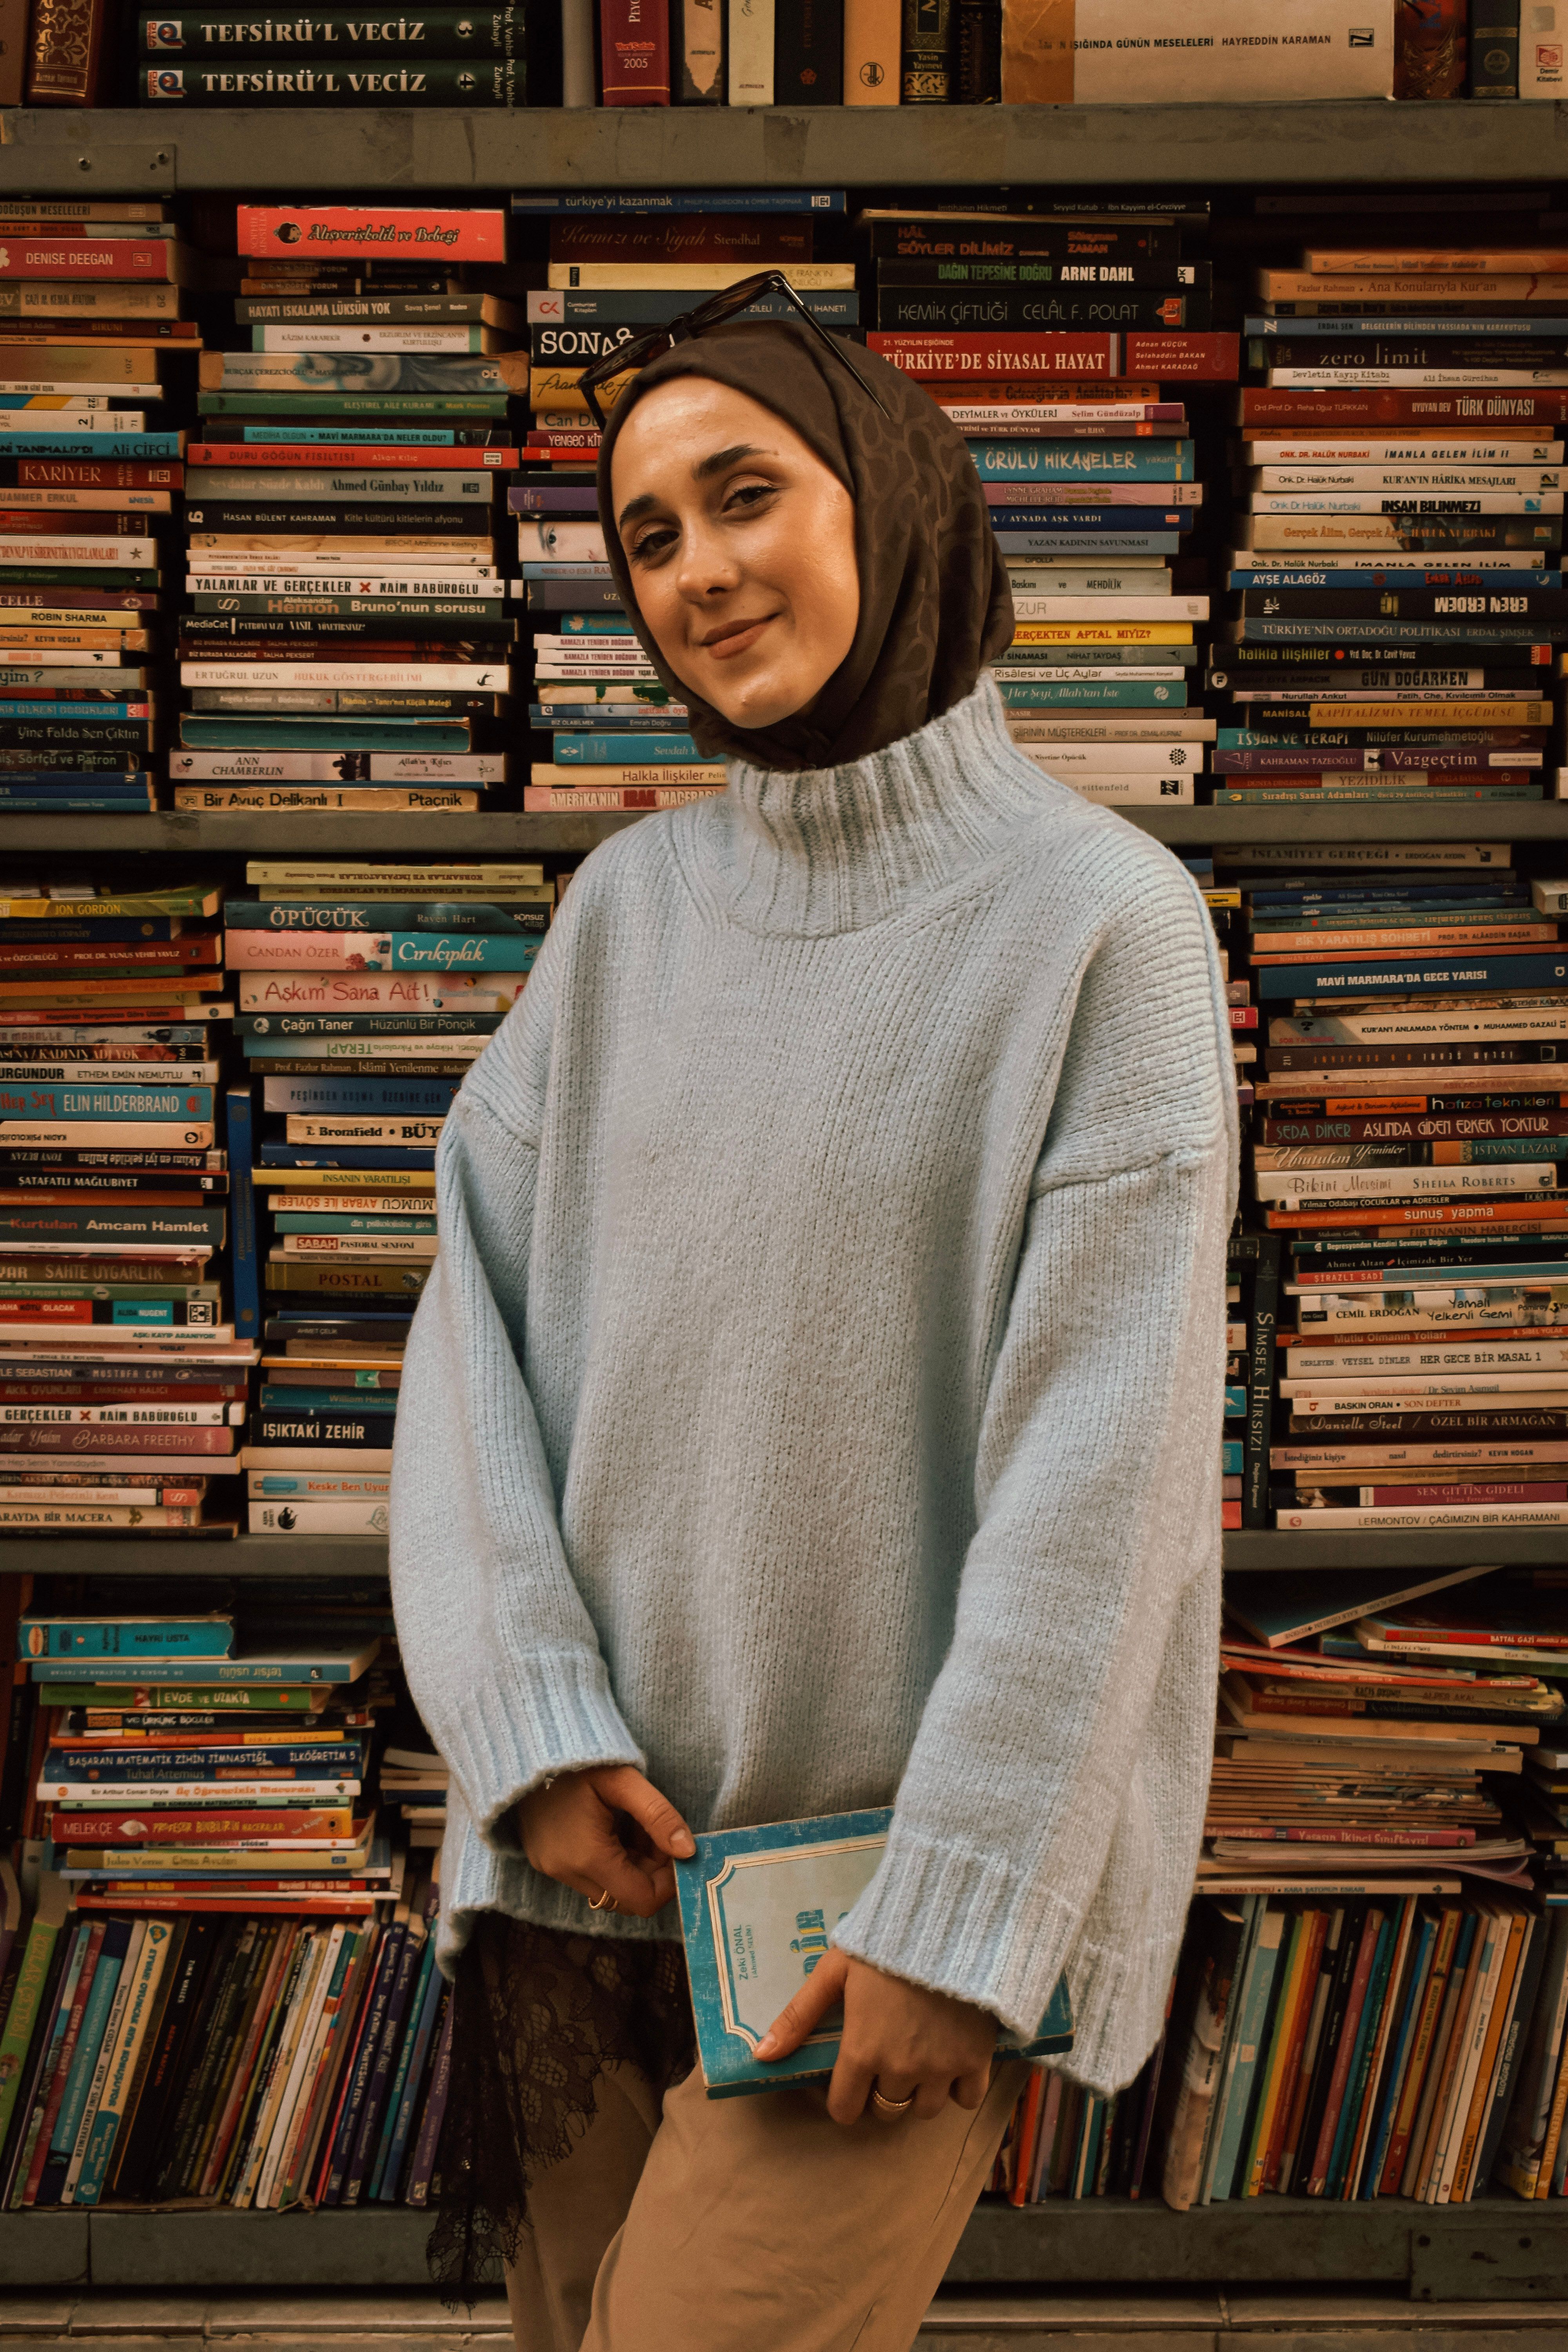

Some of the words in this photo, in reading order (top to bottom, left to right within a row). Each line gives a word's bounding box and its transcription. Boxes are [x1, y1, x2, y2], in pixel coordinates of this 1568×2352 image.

[200, 19, 338, 42] TEFSİRÜ'L
[346, 18, 425, 41] VECİZ
[458, 21, 473, 36] 3
[1116, 38, 1151, 49] GÜNÜN
[1154, 36, 1214, 48] MESELELERİ
[1222, 35, 1279, 46] HAYREDDİN
[1282, 34, 1331, 45] KARAMAN
[623, 58, 648, 69] 2005
[201, 69, 340, 92] TEFSİRÜ'L
[348, 69, 426, 91] VECİZ
[459, 74, 474, 87] 4
[565, 196, 616, 208] türkiye'yi
[620, 196, 672, 206] kazanmak
[398, 230, 411, 241] ve
[416, 229, 458, 245] Bebeği
[714, 234, 760, 245] Stendhal
[26, 253, 65, 265] DENISE
[69, 253, 113, 265] DEEGAN
[1060, 267, 1096, 281] ARNE
[1100, 267, 1134, 281] DAHL
[249, 306, 280, 317] HAYATI
[333, 301, 368, 315] LÜKSÜN
[372, 303, 390, 314] YOK
[898, 301, 946, 321] KEMİK
[951, 301, 1008, 323] ÇİFTLİĞİ
[1023, 300, 1067, 320] CELÂL
[1071, 305, 1083, 320] F.
[1089, 304, 1140, 321] POLAT
[987, 350, 1049, 369] SİYASAL
[1055, 353, 1105, 369] HAYAT
[1319, 353, 1365, 365] zero
[1375, 343, 1429, 364] limit
[1455, 396, 1484, 416] TÜRK
[1487, 395, 1534, 416] DÜNYASI
[318, 431, 339, 441] MAVİ
[341, 432, 395, 442] MARMARA'DA
[397, 433, 421, 442] NELER
[423, 433, 446, 442] OLDU?
[985, 447, 1038, 470] ÖRÜLÜ
[25, 465, 101, 482] KARİYER
[330, 480, 367, 491] Ahmed
[370, 479, 409, 494] Günbay
[413, 480, 444, 492] Yıldız
[1381, 500, 1416, 513] İNSAN
[1420, 500, 1481, 513] BİLİNMEZİ
[1252, 575, 1280, 585] AYŞE
[1283, 573, 1326, 585] ALAGÖZ
[196, 579, 258, 592] YALANLAR
[264, 581, 276, 592] VE
[284, 581, 351, 595] GERÇEKLER
[380, 581, 408, 593] NAİM
[414, 581, 478, 594] BABÜROĞLU
[268, 600, 339, 613] Hemon
[352, 601, 430, 613] Bruno'nun
[434, 603, 486, 613] sorusu
[1434, 596, 1486, 613] ERDEM
[1490, 597, 1528, 613] EREN
[186, 620, 228, 628] MediaCat
[1262, 623, 1334, 637] TÜRKİYE'NİN
[1337, 624, 1397, 637] ORTADOĞU
[1400, 624, 1460, 637] POLİTİKASI
[1361, 672, 1390, 686] GÜN
[1395, 671, 1468, 686] DOĞARKEN
[1367, 731, 1401, 742] Nilüfer
[1404, 730, 1493, 743] Kurumehmetoğlu
[235, 757, 260, 765] ANN
[1392, 752, 1477, 769] Vazgeçtim
[212, 766, 283, 775] CHAMBERLIN
[622, 771, 659, 780] Halkla
[663, 769, 704, 781] İlişkiler
[1339, 774, 1405, 786] YEZİDİLİK
[205, 793, 223, 806] Bir
[229, 793, 263, 808] Avuç
[270, 792, 327, 806] Delikanlı
[337, 794, 343, 806] I
[408, 793, 462, 806] Ptacnik
[55, 905, 74, 915] JON
[77, 904, 121, 915] GORDON
[270, 906, 369, 927] ÖPÜCÜK
[417, 914, 446, 924] Raven
[453, 915, 475, 924] Hart
[248, 947, 301, 957] CANDAN
[306, 946, 340, 957] ÖZER
[399, 940, 488, 969] Çırılçıplak
[1317, 975, 1345, 987] MAVİ
[1348, 974, 1421, 985] MARMARA'DA
[1423, 973, 1449, 983] GECE
[1452, 970, 1487, 981] YARISI
[265, 982, 325, 1003] Aşkım
[334, 983, 379, 1001] Sana
[389, 982, 429, 1001] Ait!
[281, 1020, 314, 1031] Çağrı
[318, 1020, 353, 1030] Taner
[370, 1019, 414, 1029] Hüzünlü
[419, 1020, 434, 1029] Bir
[437, 1020, 476, 1031] Ponçik
[64, 1095, 90, 1112] ELIN
[94, 1095, 179, 1112] HILDERBRAND
[319, 1127, 382, 1136] Bromfield
[1276, 1125, 1309, 1140] SEDA
[1316, 1122, 1351, 1138] DİKER
[1364, 1120, 1412, 1136] ASLINDA
[1418, 1118, 1450, 1135] GİDEN
[1456, 1118, 1495, 1133] ERKEK
[1501, 1118, 1549, 1132] YOKTUR
[1475, 1145, 1518, 1155] ISTVAN
[1521, 1143, 1557, 1154] LAZAR
[18, 1177, 70, 1187] ŞATAFATLI
[74, 1176, 138, 1187] MAĞLUBİYET
[1413, 1178, 1456, 1189] SHEILA
[1462, 1176, 1515, 1187] ROBERTS
[1405, 1208, 1443, 1221] sunuş
[1451, 1207, 1494, 1219] yapma
[10, 1219, 77, 1228] Kurtulan
[86, 1220, 147, 1230] Amcam
[152, 1221, 208, 1232] Hamlet
[298, 1238, 338, 1249] SABAH
[45, 1265, 87, 1279] SAHTE
[94, 1266, 163, 1279] UYGARLIK
[319, 1274, 382, 1286] POSTAL
[1420, 1355, 1440, 1364] HER
[1443, 1355, 1471, 1363] GECE
[1474, 1353, 1495, 1363] BİR
[1497, 1352, 1530, 1361] MASAL
[1535, 1352, 1541, 1361] 1
[263, 1422, 319, 1439] IŞIKTAKİ
[325, 1423, 364, 1439] ZEHİR
[73, 1430, 140, 1449] BARBARA
[143, 1435, 195, 1445] FREETHY
[166, 1634, 190, 1642] USTA
[1517, 1635, 1534, 1643] GAZİ
[68, 1755, 114, 1766] BAŞARAN
[117, 1755, 172, 1765] MATEMATİK
[289, 1750, 347, 1762] İLKÖĞRETİM
[350, 1751, 355, 1760] 5
[734, 1924, 745, 1953] ÖNAL
[738, 1955, 748, 1980] Zeki
